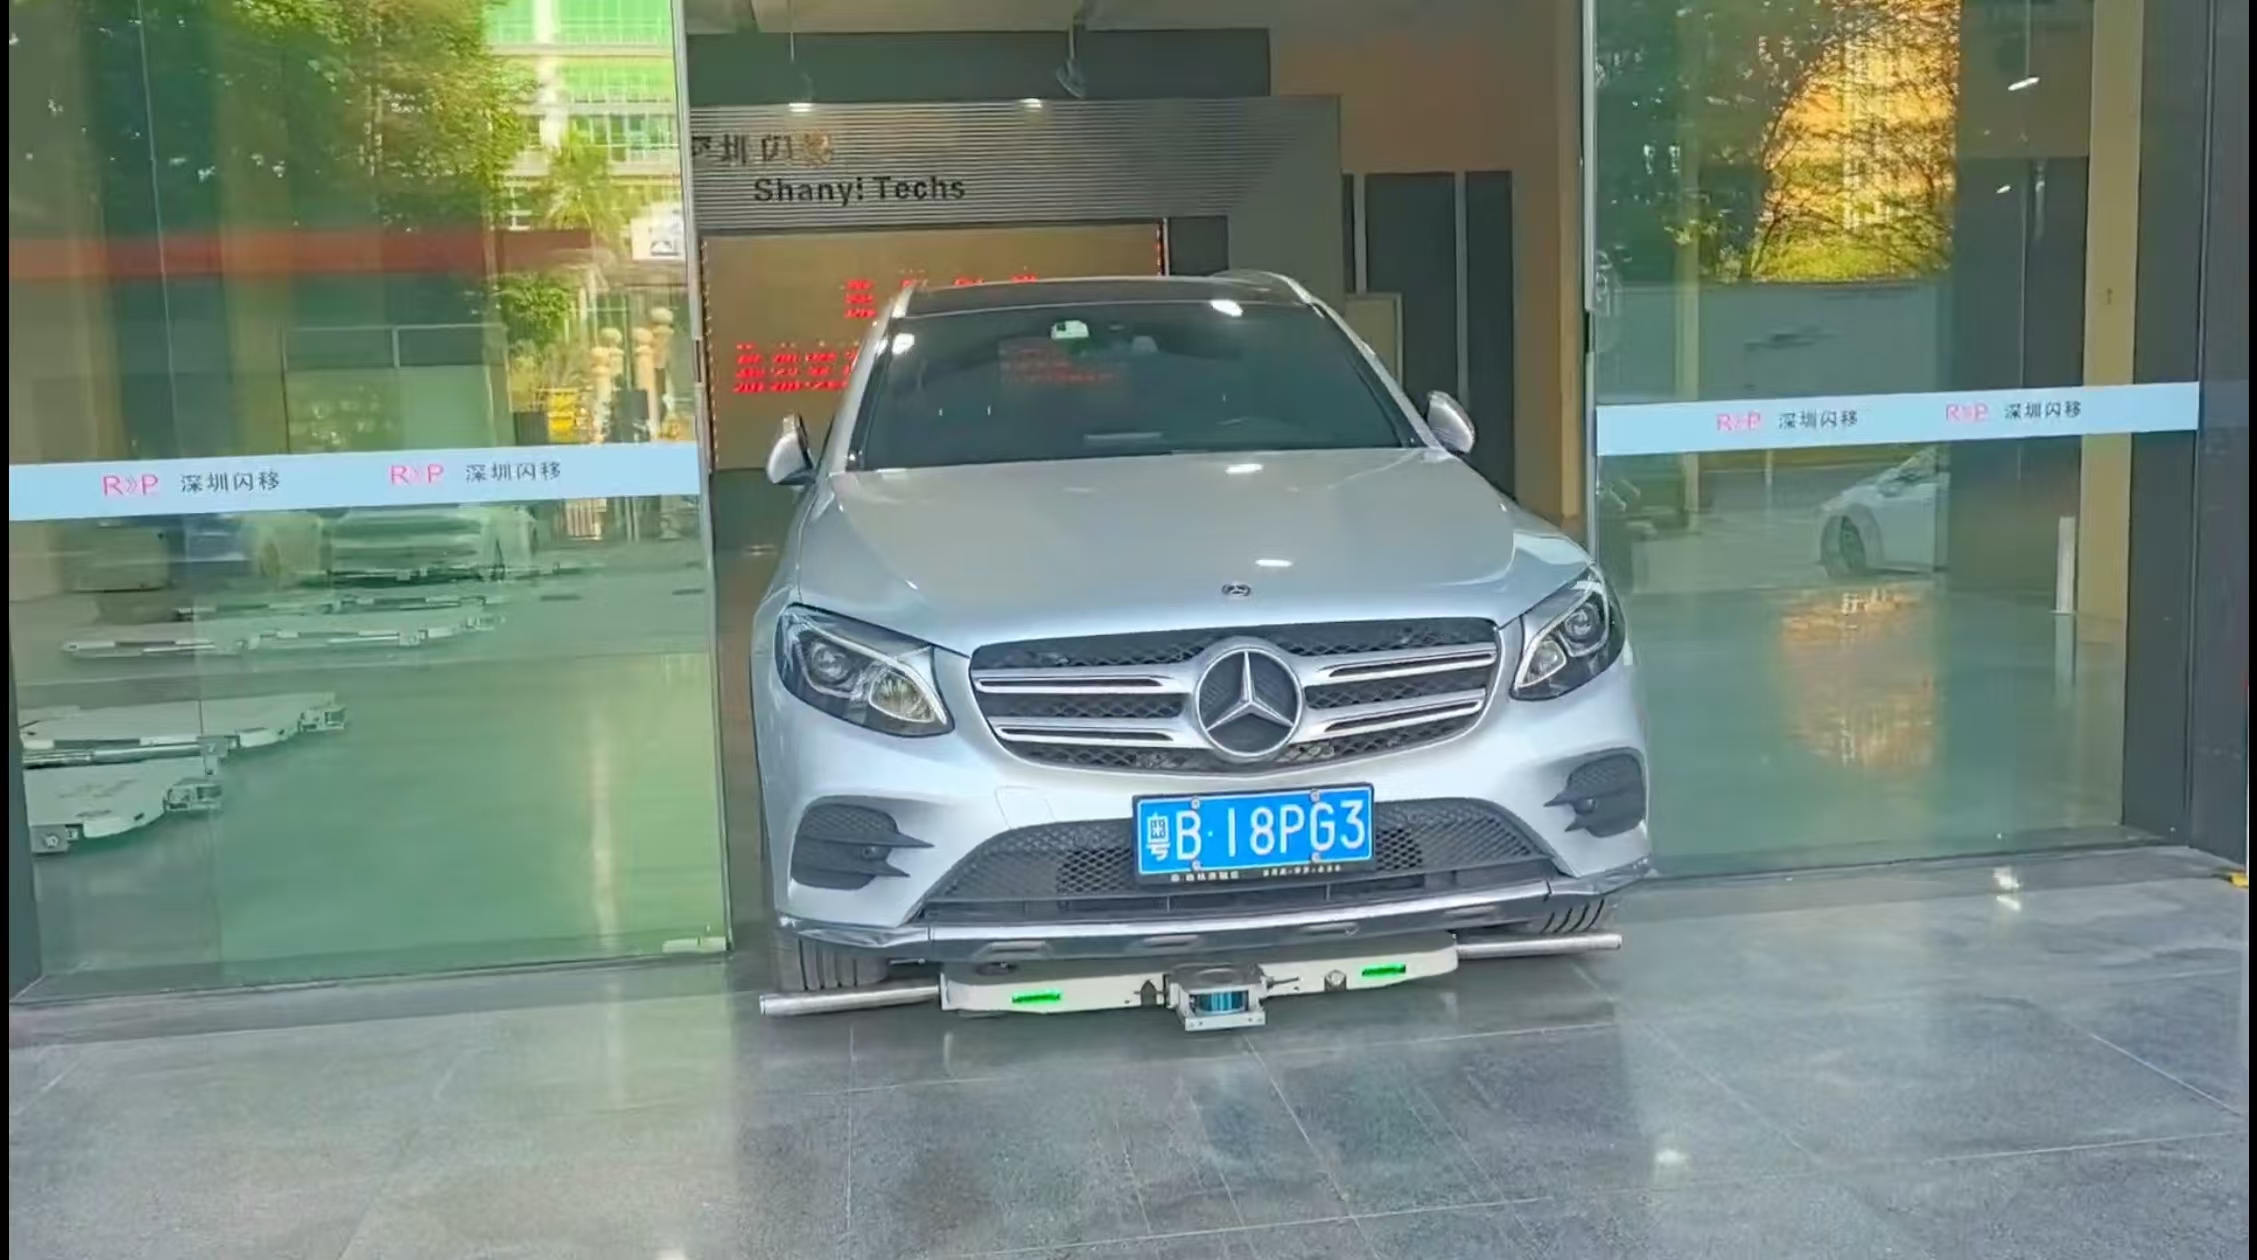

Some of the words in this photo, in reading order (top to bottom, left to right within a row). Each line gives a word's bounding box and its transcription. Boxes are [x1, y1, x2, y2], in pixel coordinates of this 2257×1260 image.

[871, 175, 966, 200] Techs
[1779, 409, 1859, 430] 深圳闪移
[2004, 401, 2082, 420] 深圳闪移
[180, 470, 281, 494] 深圳闪移
[465, 461, 562, 483] 深圳闪移
